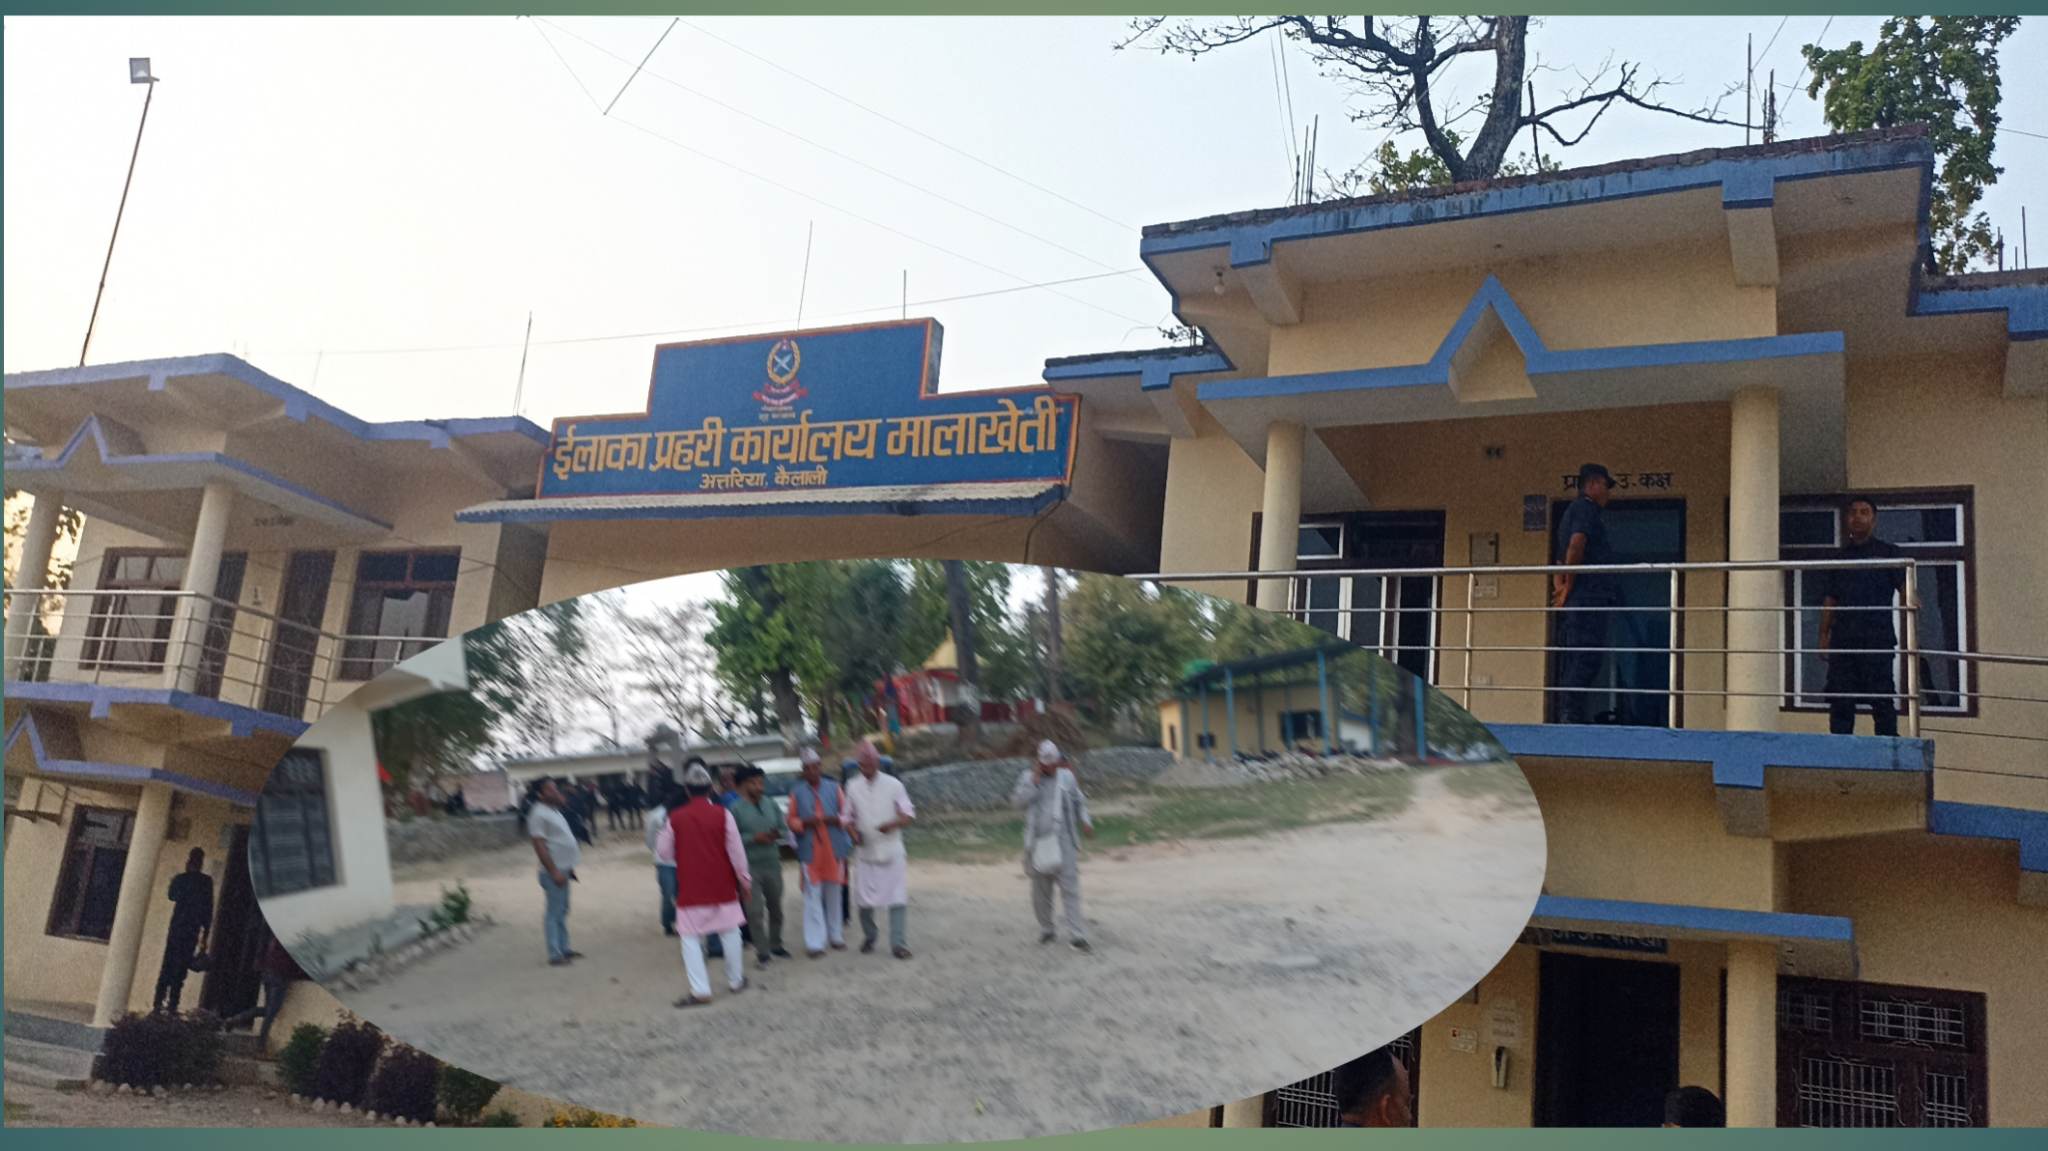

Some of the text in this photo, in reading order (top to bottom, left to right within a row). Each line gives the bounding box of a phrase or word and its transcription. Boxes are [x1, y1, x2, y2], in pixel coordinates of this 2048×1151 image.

[553, 395, 1064, 480] ईलाका प्रहरी कार्यालय मालाखेती
